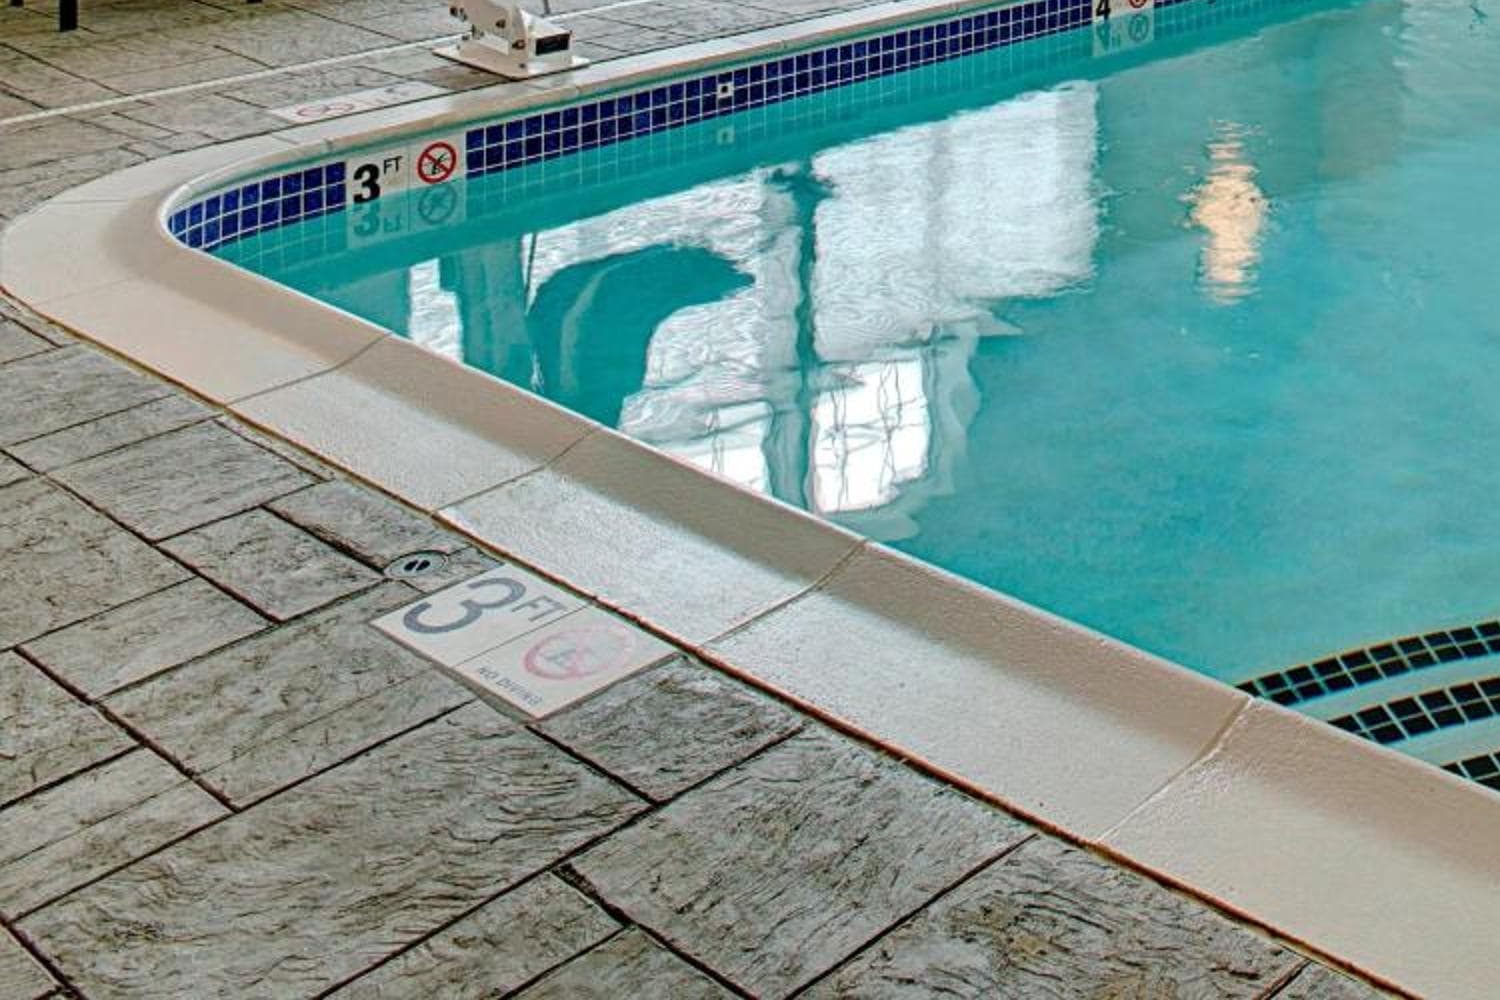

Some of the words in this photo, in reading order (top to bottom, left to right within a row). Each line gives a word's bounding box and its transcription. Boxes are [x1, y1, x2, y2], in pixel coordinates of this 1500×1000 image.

[353, 163, 381, 204] 3
[383, 155, 403, 175] FT
[403, 577, 527, 634] 3
[511, 595, 567, 622] FT
